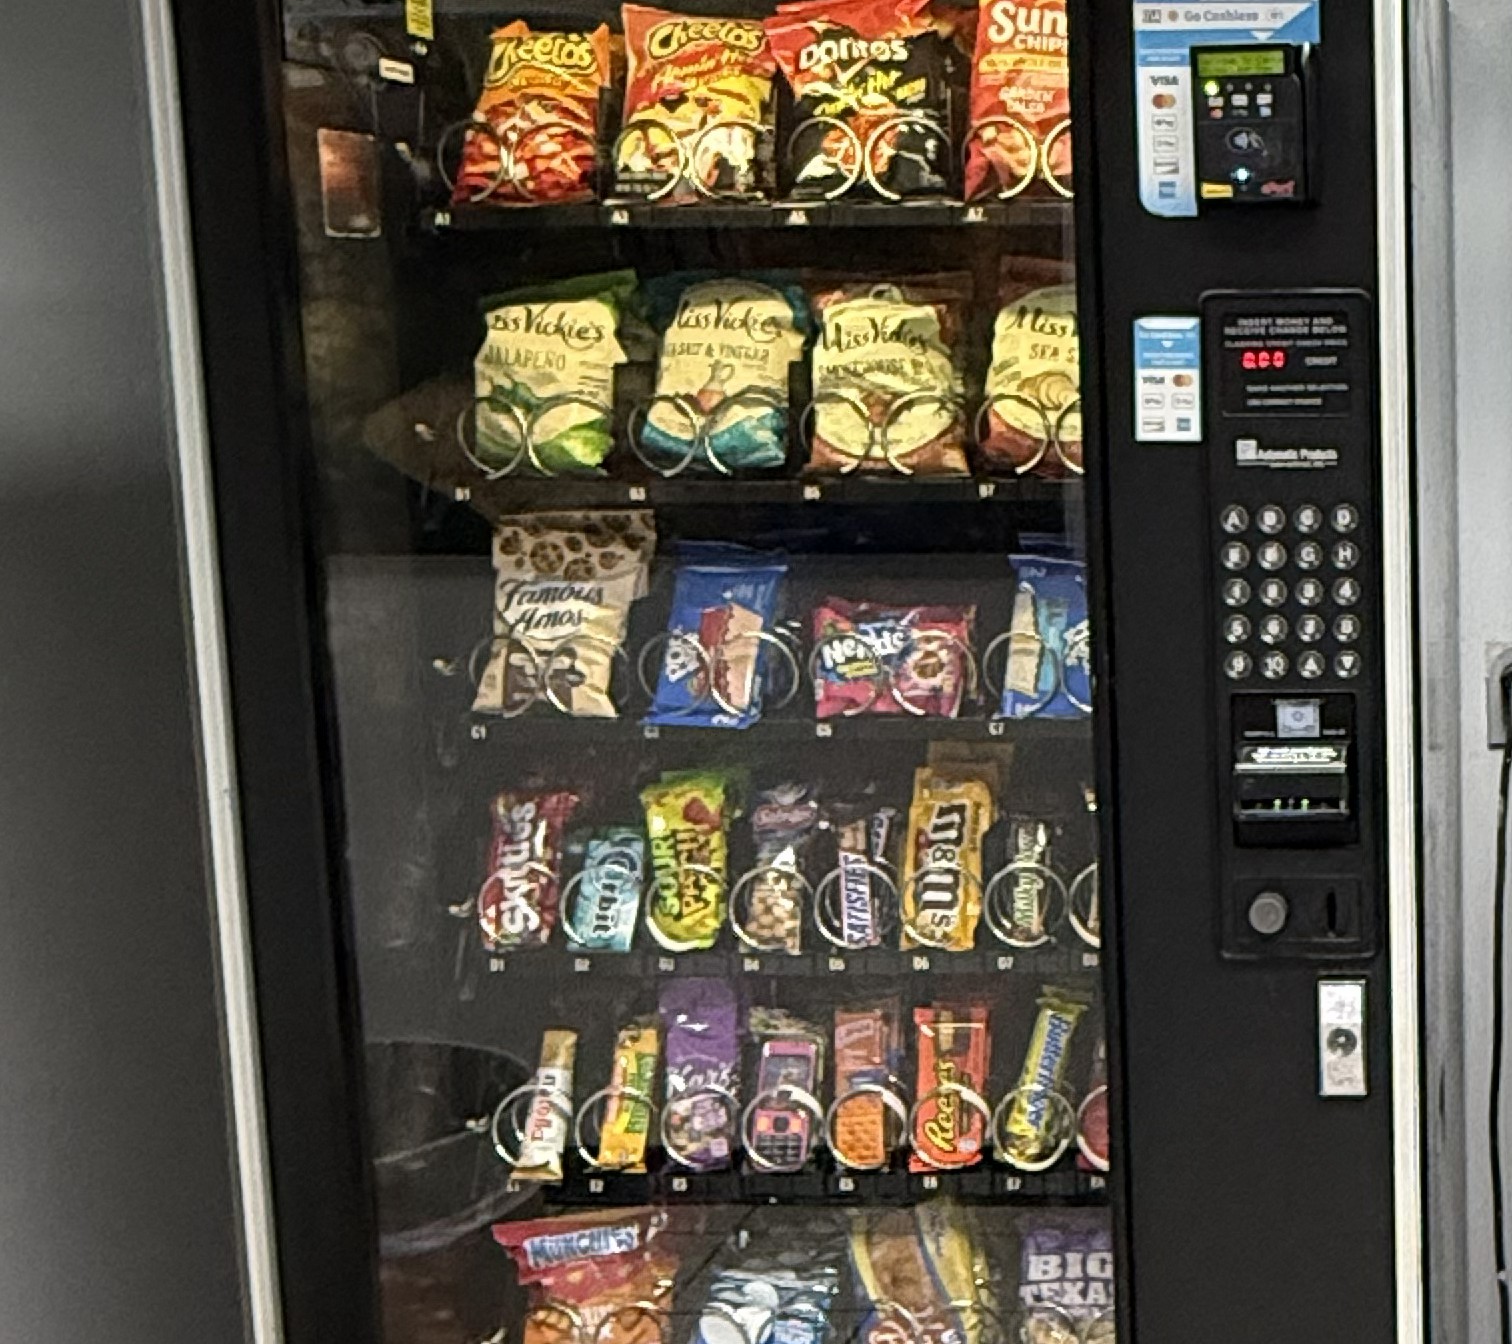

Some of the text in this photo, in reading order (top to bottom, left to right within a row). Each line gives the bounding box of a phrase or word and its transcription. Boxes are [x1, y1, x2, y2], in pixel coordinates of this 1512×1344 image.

[988, 0, 1067, 43] Sun
[1184, 10, 1259, 22] Go Cashless
[651, 22, 763, 57] Cheetos
[799, 37, 908, 70] Doritos
[1150, 76, 1180, 86] VISA
[968, 207, 985, 222] A7
[524, 305, 606, 350] Vickie's
[1005, 305, 1068, 338] Miss
[1029, 343, 1062, 360] SEA
[1227, 511, 1240, 526] A
[1337, 508, 1350, 524] D
[1301, 546, 1315, 561] G
[1338, 546, 1351, 561] H
[500, 580, 604, 608] Famous
[514, 608, 584, 632] Amos
[651, 833, 680, 917] SOUR
[1027, 1012, 1071, 1128] Butterfinger
[1027, 1252, 1113, 1282] BIG
[1019, 1281, 1114, 1307] TEXA
